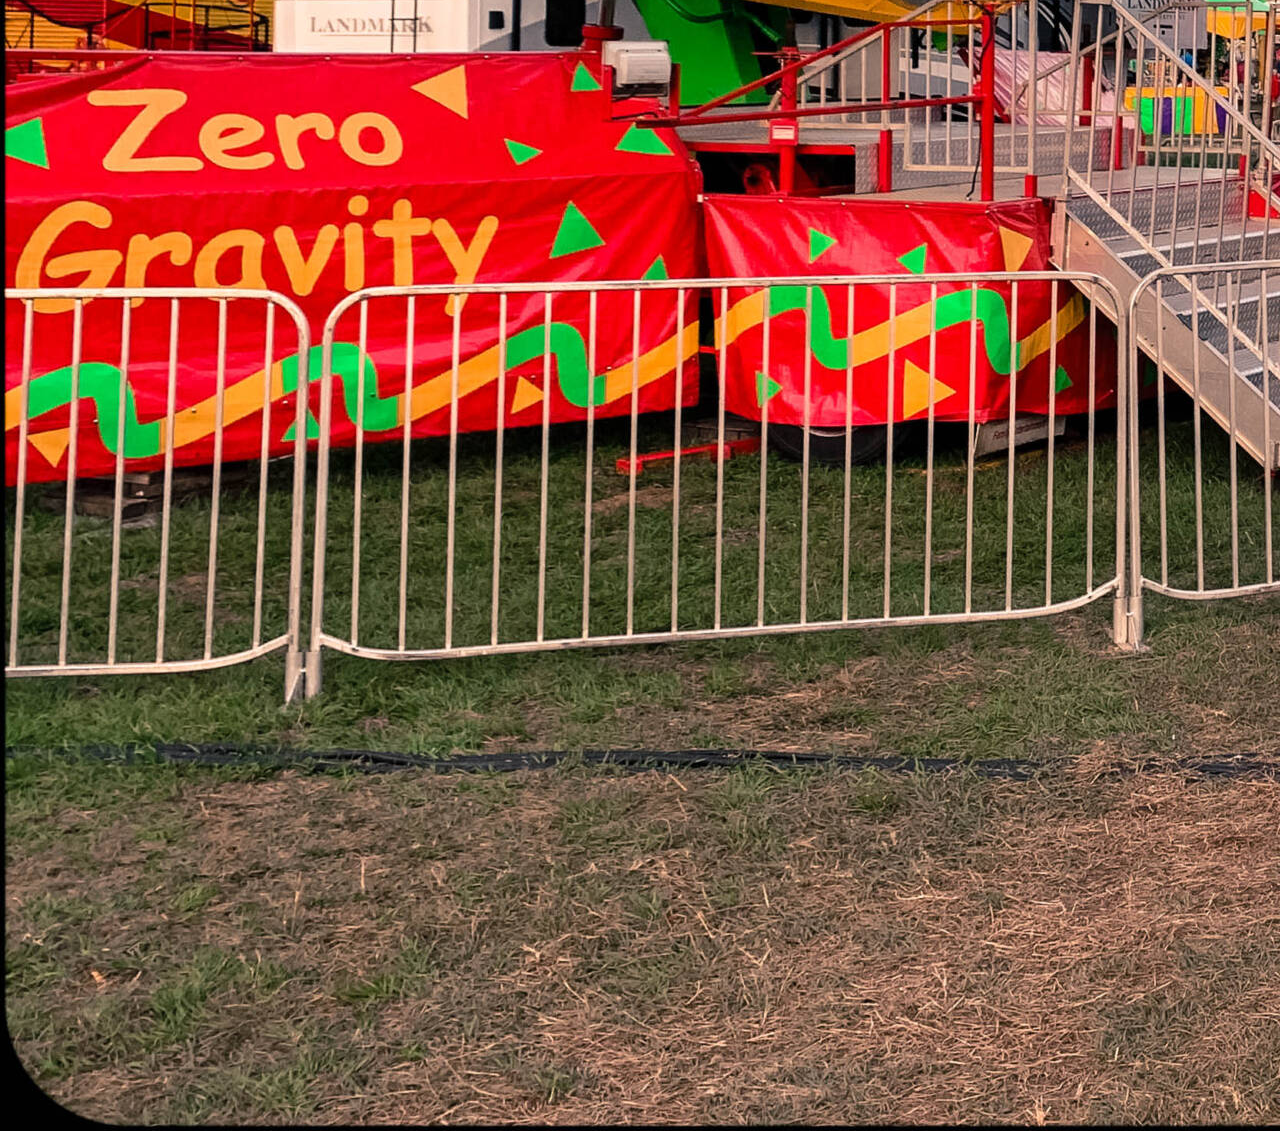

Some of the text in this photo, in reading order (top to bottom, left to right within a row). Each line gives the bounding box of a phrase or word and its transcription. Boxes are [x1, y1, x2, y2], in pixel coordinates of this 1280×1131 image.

[310, 16, 433, 34] LANDMARK
[86, 88, 404, 173] Zero
[14, 195, 500, 316] Gravity
